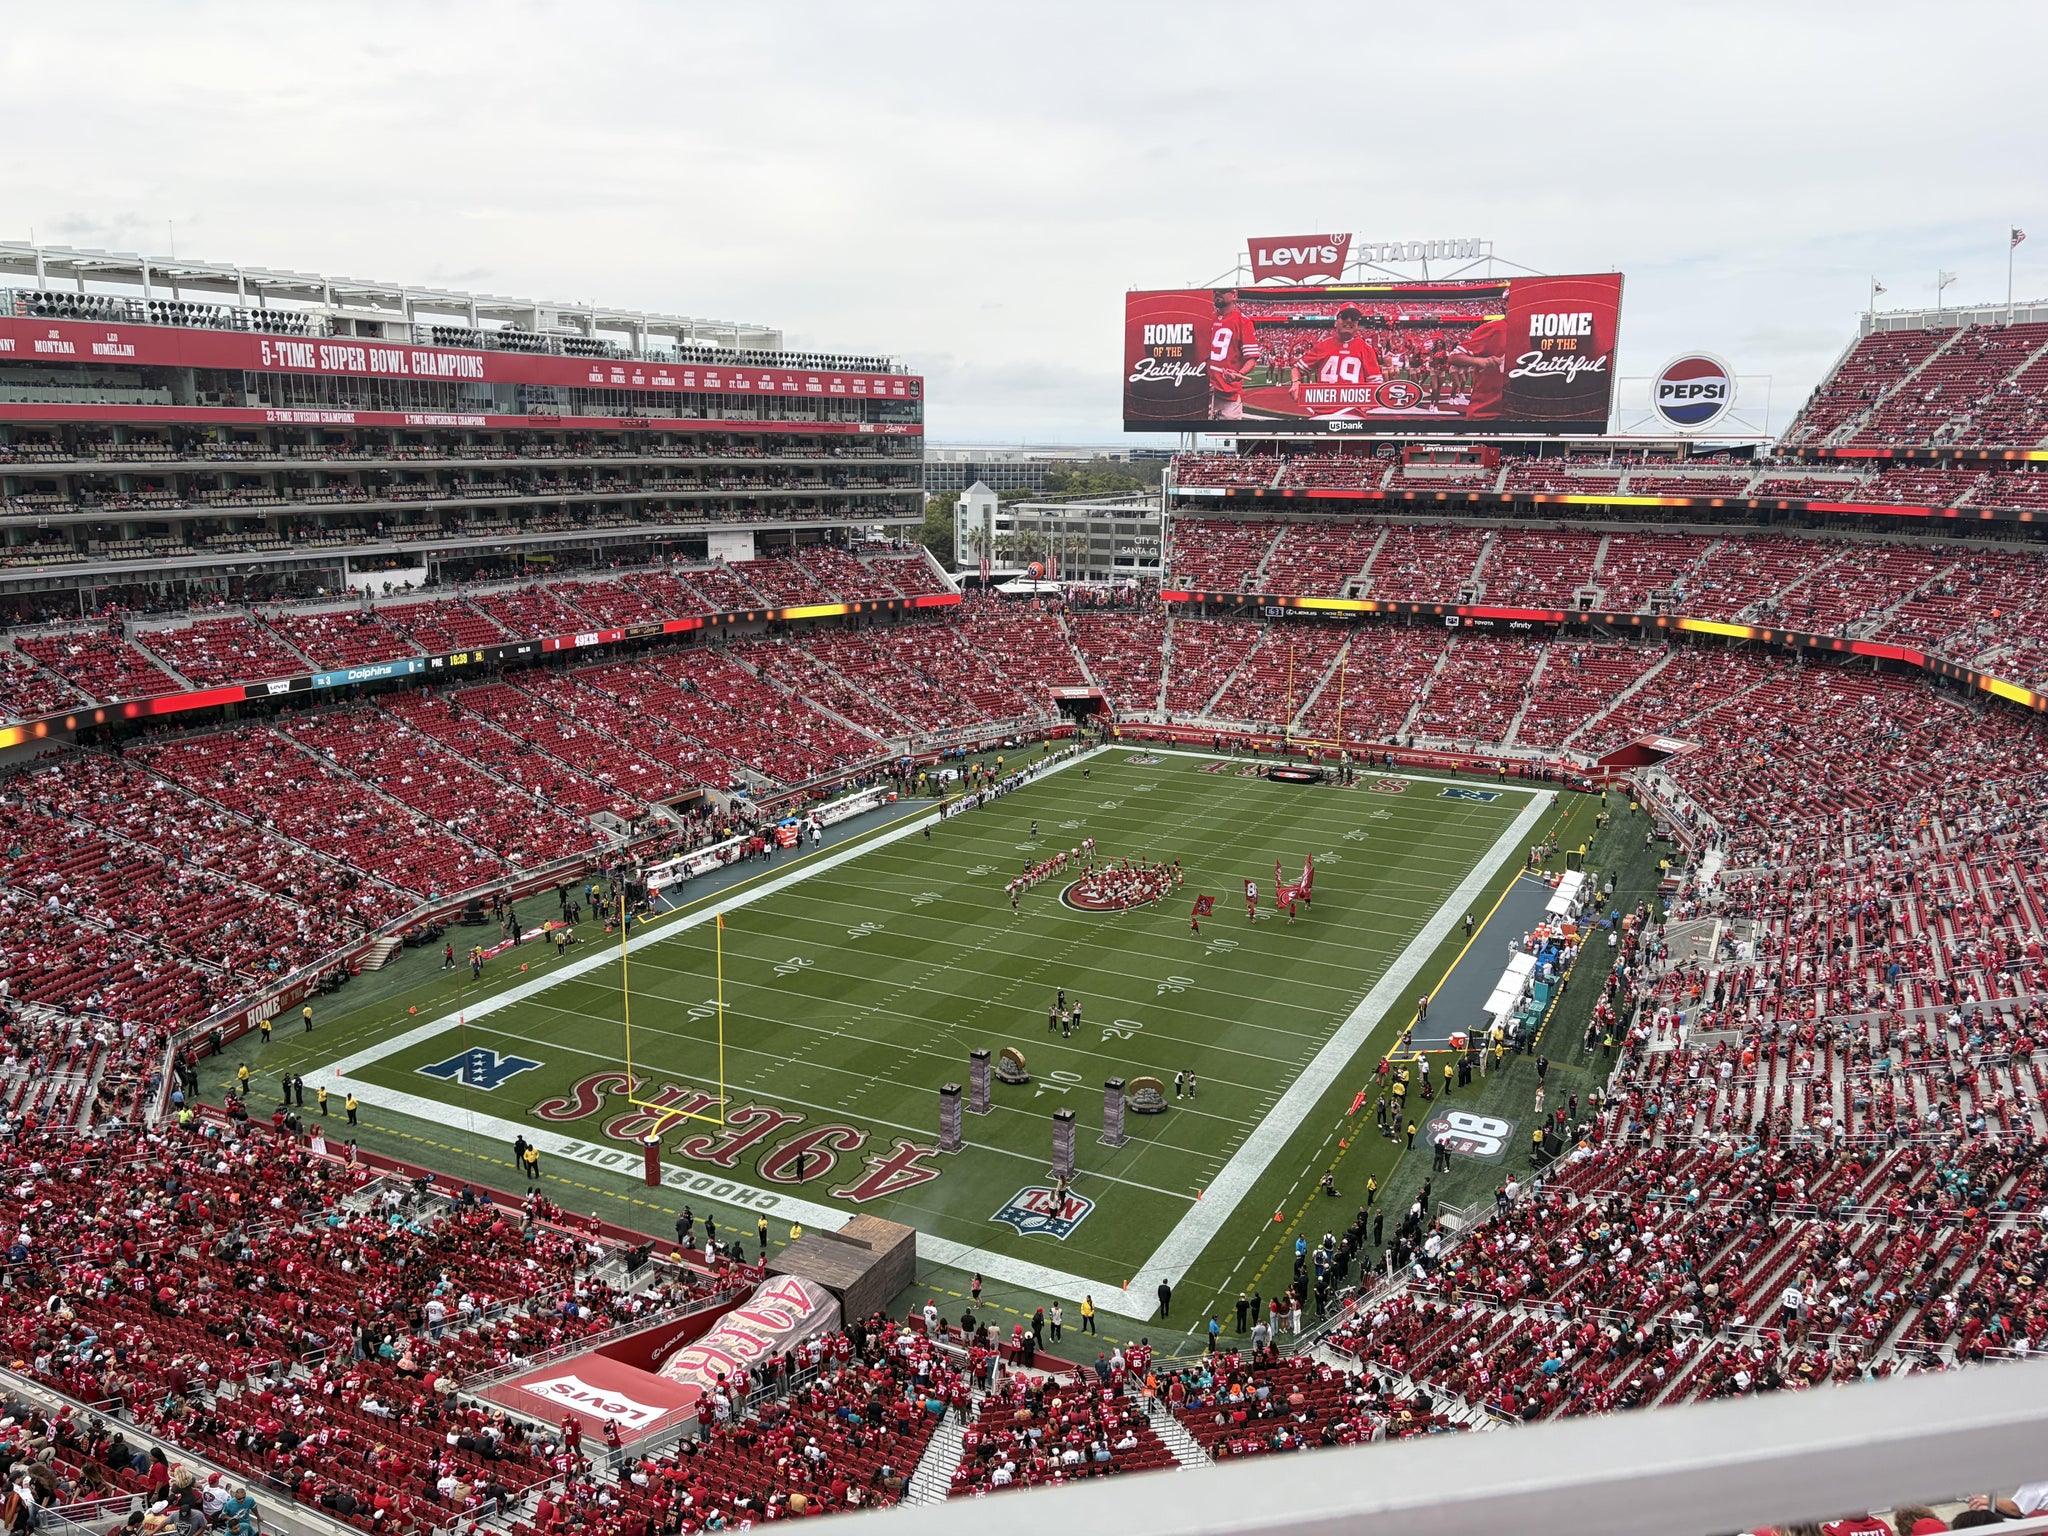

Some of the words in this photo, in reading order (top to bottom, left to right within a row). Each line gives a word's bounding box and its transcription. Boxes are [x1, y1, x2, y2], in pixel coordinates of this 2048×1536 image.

[1357, 237, 1480, 263] STADIUM
[1529, 312, 1592, 336] HOME
[1144, 323, 1193, 345] HOME
[34, 340, 75, 354] MONTANA
[92, 343, 135, 356] NOMELLINI
[1153, 347, 1164, 357] OF
[1167, 346, 1182, 357] THE
[1541, 339, 1554, 350] OF
[1557, 339, 1577, 350] THE
[261, 340, 315, 369] 5-TIME
[320, 345, 366, 372] SUPER
[369, 348, 409, 374] BOWL
[411, 351, 484, 378] CHAMPIONS
[1129, 357, 1206, 387] Faithful
[1509, 351, 1607, 383] Faithful
[1305, 388, 1337, 403] NINER
[1340, 388, 1371, 403] NOISE
[1659, 383, 1725, 399] PEPSI
[266, 410, 292, 422] 22-TIME
[293, 411, 320, 422] DIVISION
[321, 412, 355, 423] CHAMPIONS
[458, 416, 486, 426] CHAMPIONS
[1134, 536, 1151, 544] CITY
[1122, 547, 1147, 555] SANTA
[1509, 621, 1532, 629] xfinity
[555, 638, 560, 649] 0
[574, 632, 599, 647] 49ERS
[409, 662, 414, 673] 0
[431, 657, 443, 668] PRE
[450, 655, 467, 666] 16:38
[348, 665, 392, 680] Dolphins
[326, 676, 331, 685] 3
[847, 921, 885, 936] 30
[773, 956, 815, 974] 20
[1157, 975, 1195, 993] 30
[246, 995, 280, 1028] HOME
[686, 999, 731, 1018] 10
[1102, 1019, 1144, 1040] 20
[1038, 1070, 1083, 1095] 10
[557, 1141, 644, 1171] LOVE
[134, 1281, 145, 1291] 16
[1786, 1294, 1797, 1306] 13
[661, 1330, 685, 1351] LEXUS
[1322, 1372, 1332, 1381] 54
[565, 1426, 572, 1435] 16
[967, 1436, 978, 1444] 23
